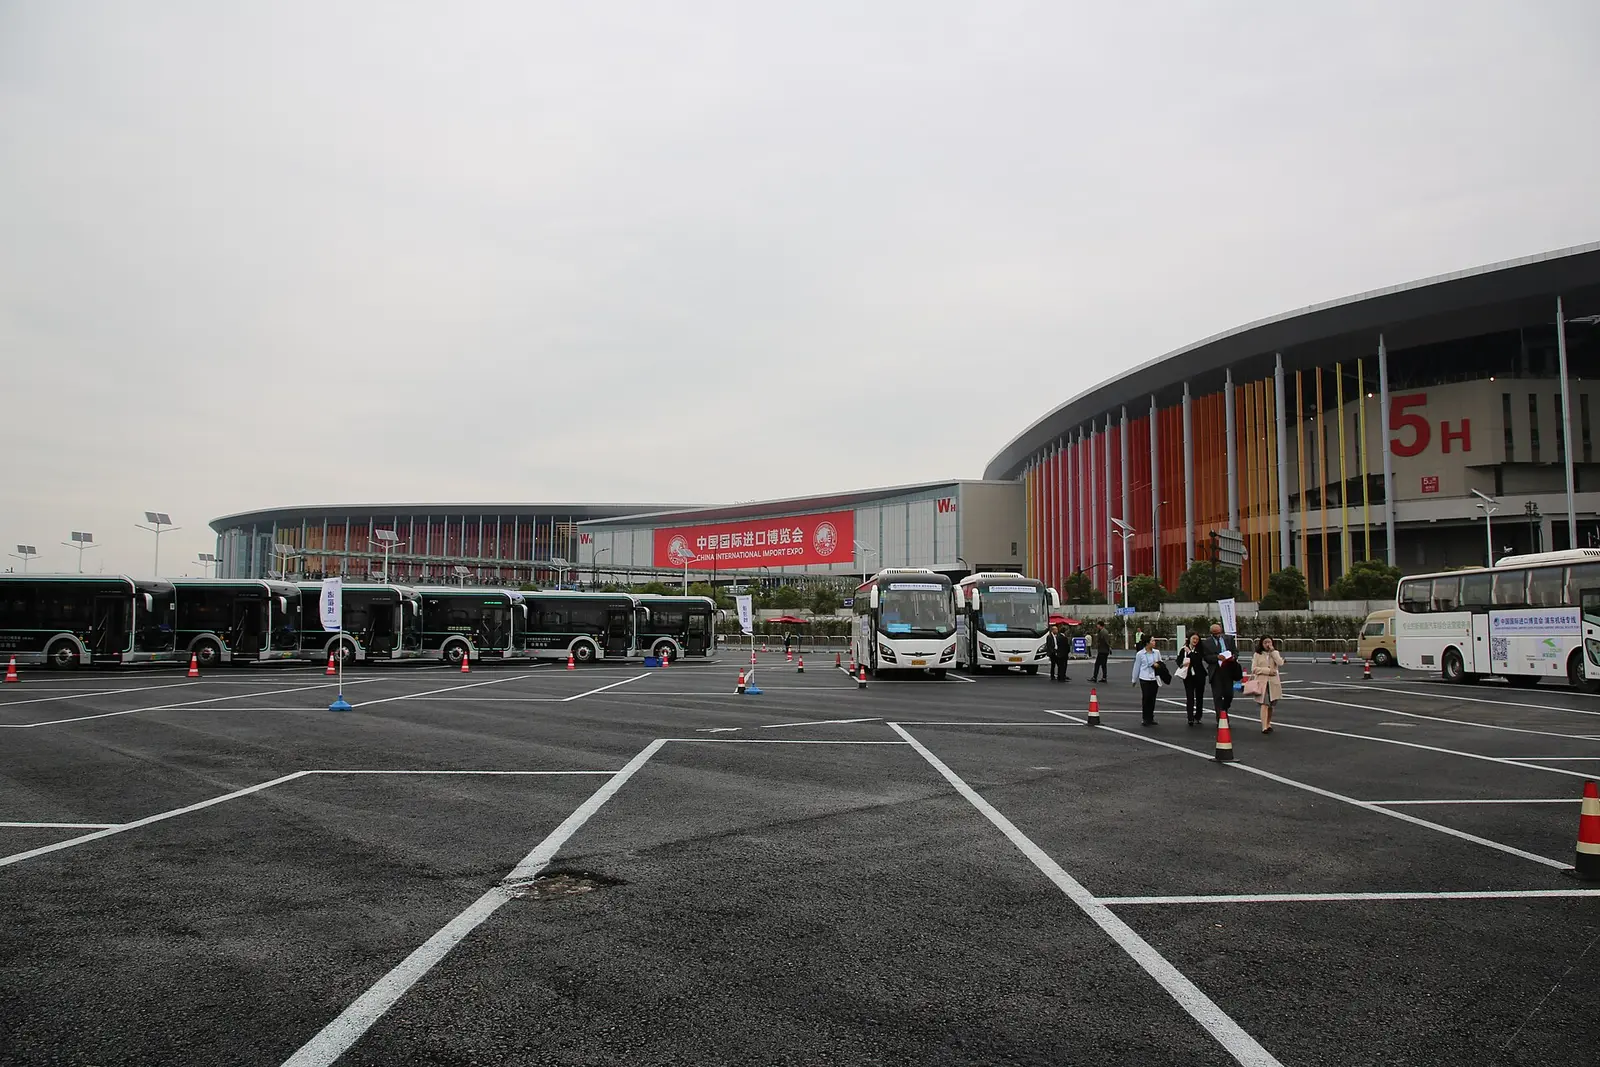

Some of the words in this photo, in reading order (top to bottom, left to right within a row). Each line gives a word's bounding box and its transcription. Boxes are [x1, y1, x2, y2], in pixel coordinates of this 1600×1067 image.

[937, 498, 956, 513] WH
[696, 527, 804, 551] 中国国际进口博览会
[696, 552, 715, 561] CHINA
[715, 550, 761, 560] INTERNATIONAL
[762, 548, 786, 557] IMPORT
[786, 547, 804, 555] EXPO
[1500, 616, 1543, 625] 中国国际进口博览会
